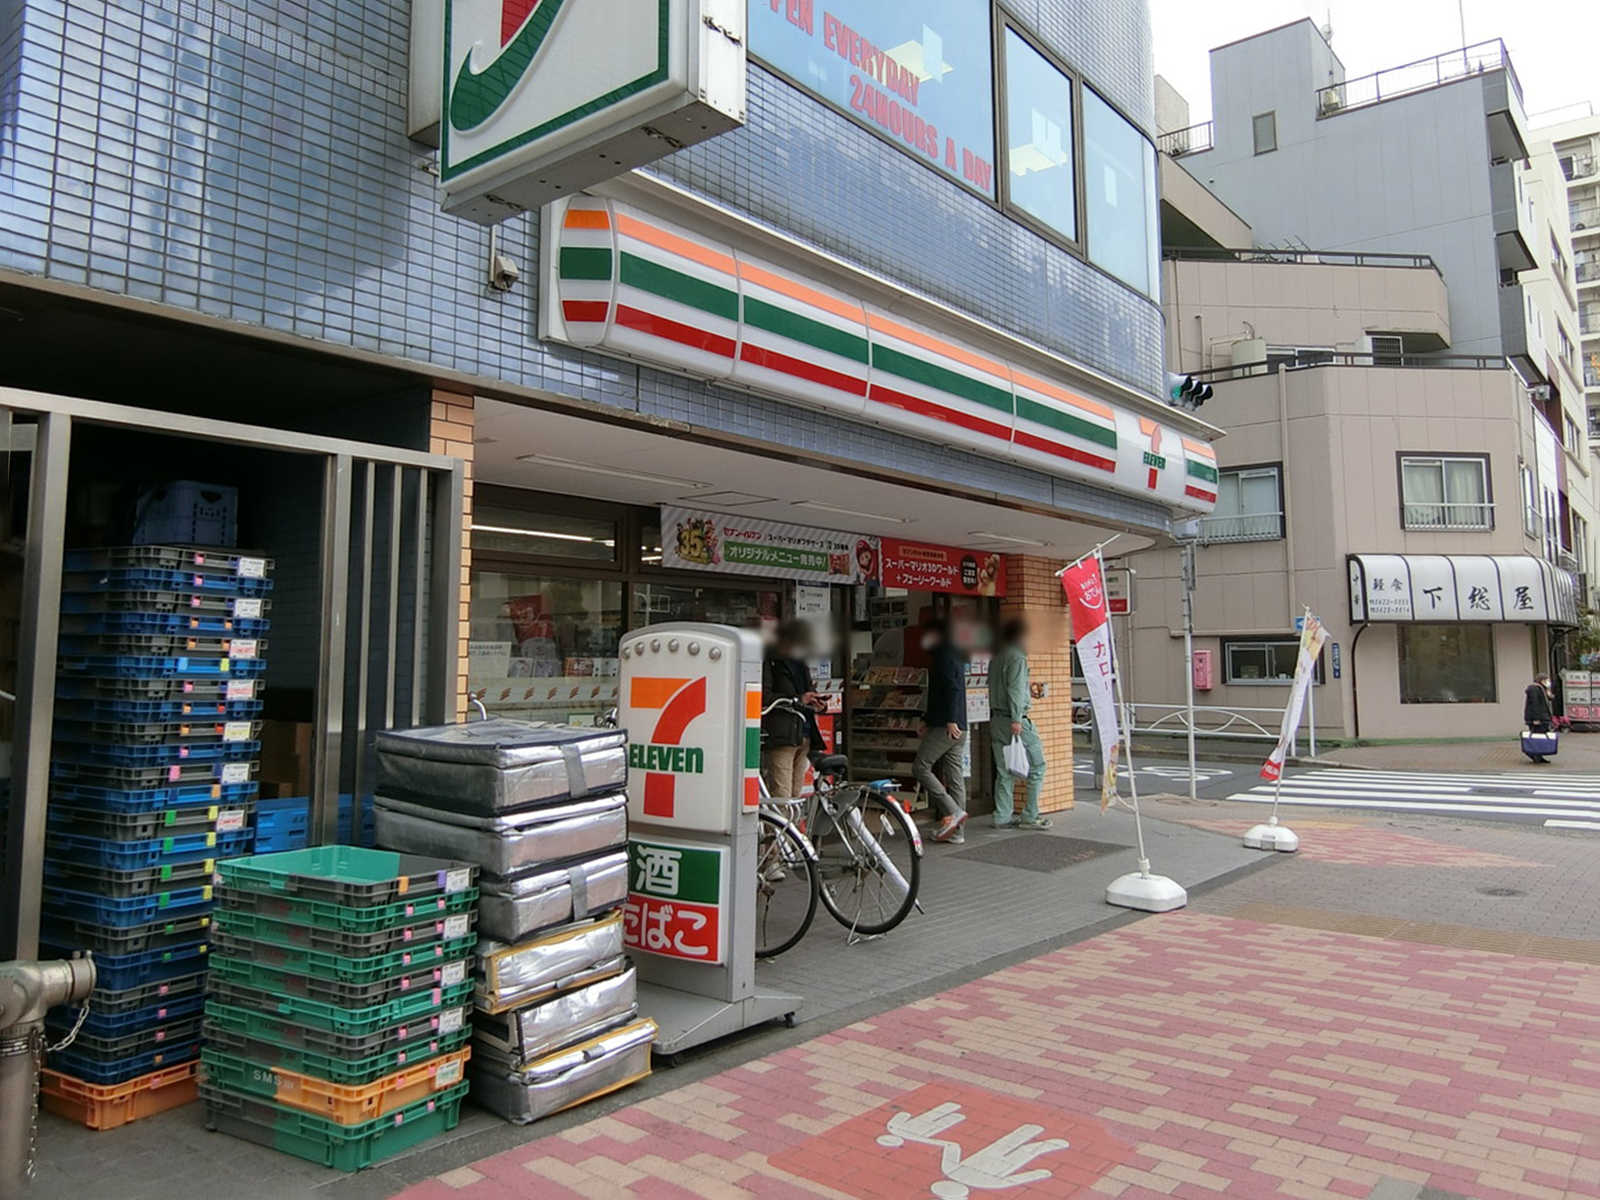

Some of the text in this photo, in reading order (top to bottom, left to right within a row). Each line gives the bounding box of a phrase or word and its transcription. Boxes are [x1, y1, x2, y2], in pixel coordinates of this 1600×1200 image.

[764, 0, 919, 107] EN EVERYDAY
[850, 74, 992, 193] 24HOURS A DAY
[636, 844, 683, 896] 酒
